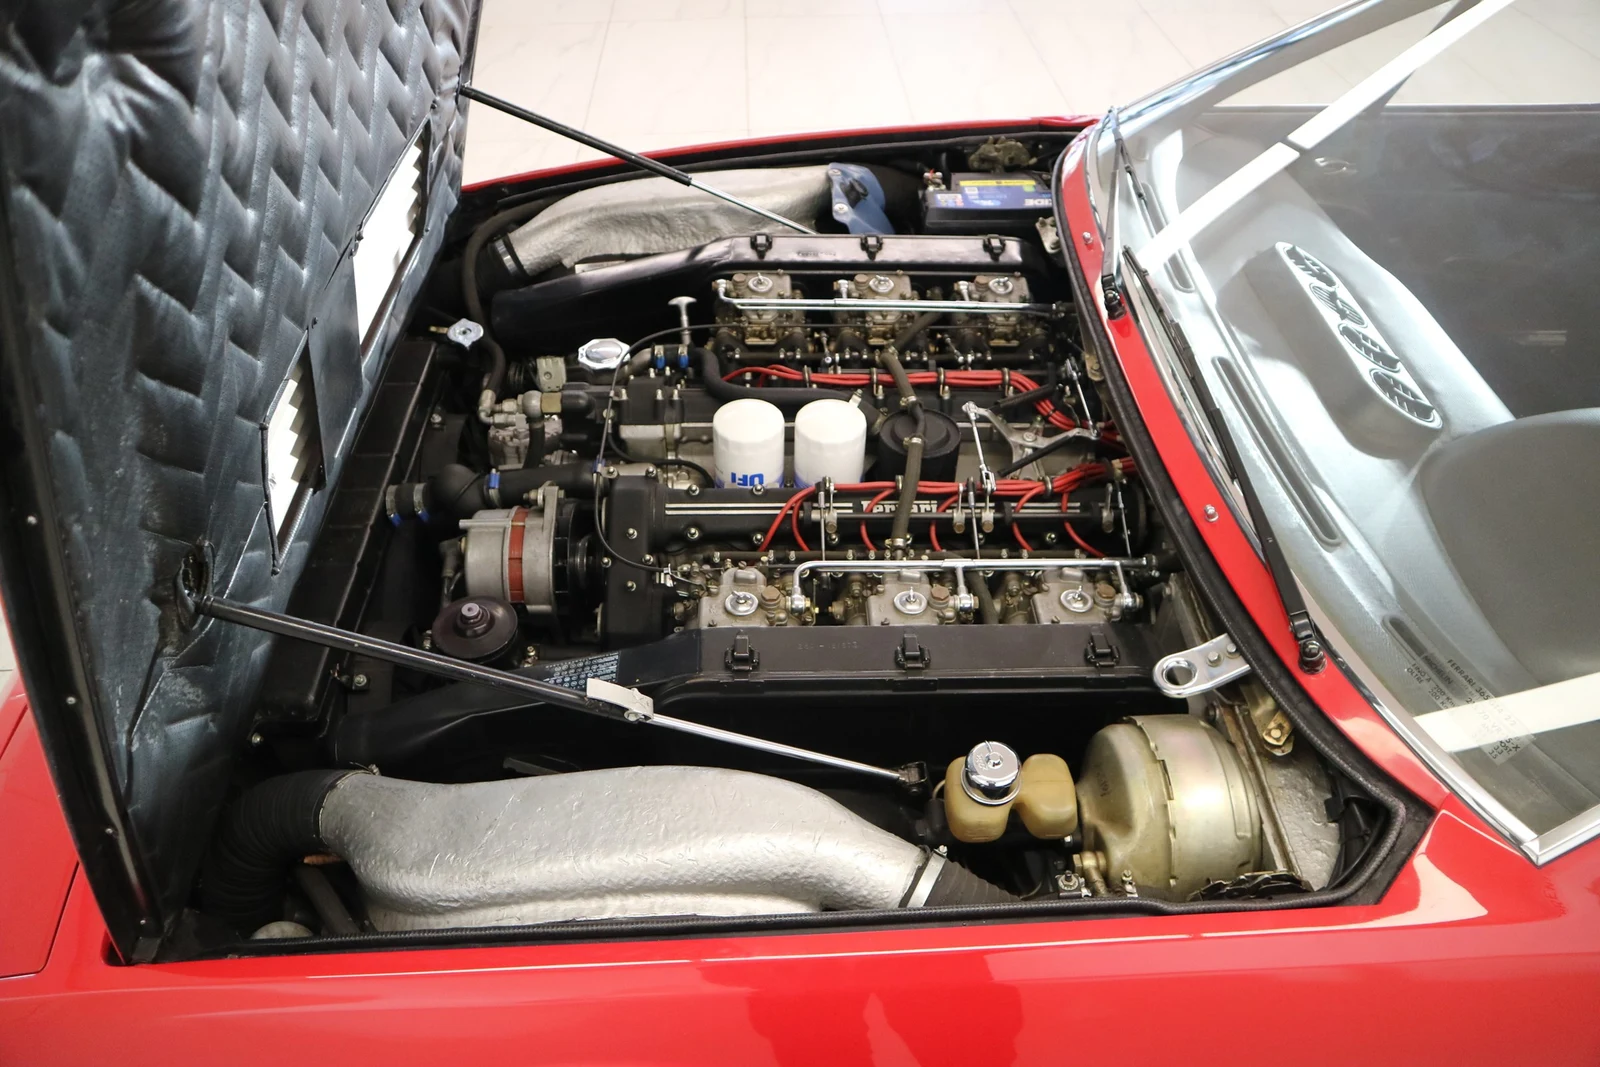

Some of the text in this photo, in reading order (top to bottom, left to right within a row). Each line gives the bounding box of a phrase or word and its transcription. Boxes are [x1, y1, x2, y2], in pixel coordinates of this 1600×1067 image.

[730, 472, 764, 487] UFI
[1422, 654, 1453, 685] MICHELIN
[1446, 657, 1476, 687] FERRARI
[1475, 685, 1490, 701] 365
